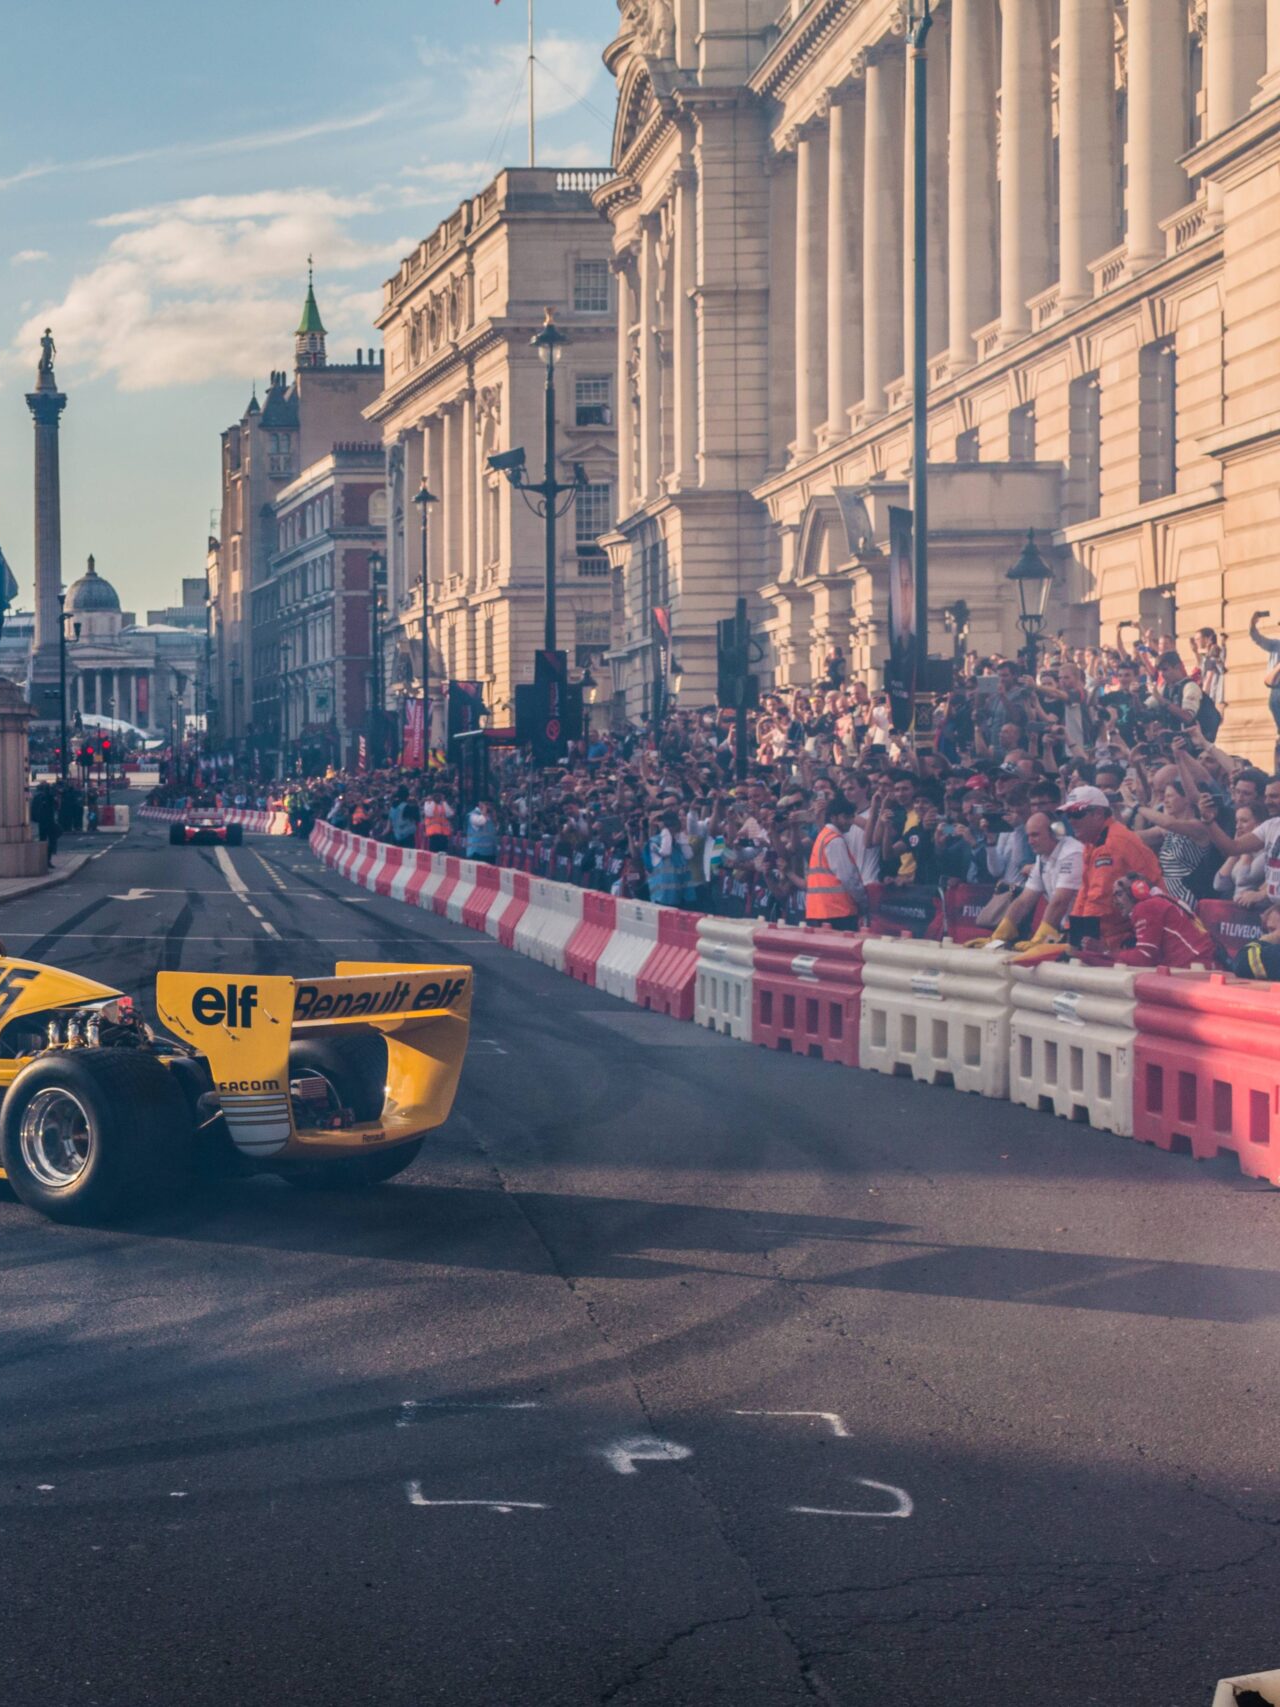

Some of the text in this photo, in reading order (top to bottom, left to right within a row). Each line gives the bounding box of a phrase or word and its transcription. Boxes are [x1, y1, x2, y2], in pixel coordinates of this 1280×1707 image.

[192, 983, 258, 1028] elf
[293, 978, 467, 1021] Renault elf
[219, 1079, 280, 1092] FACOM
